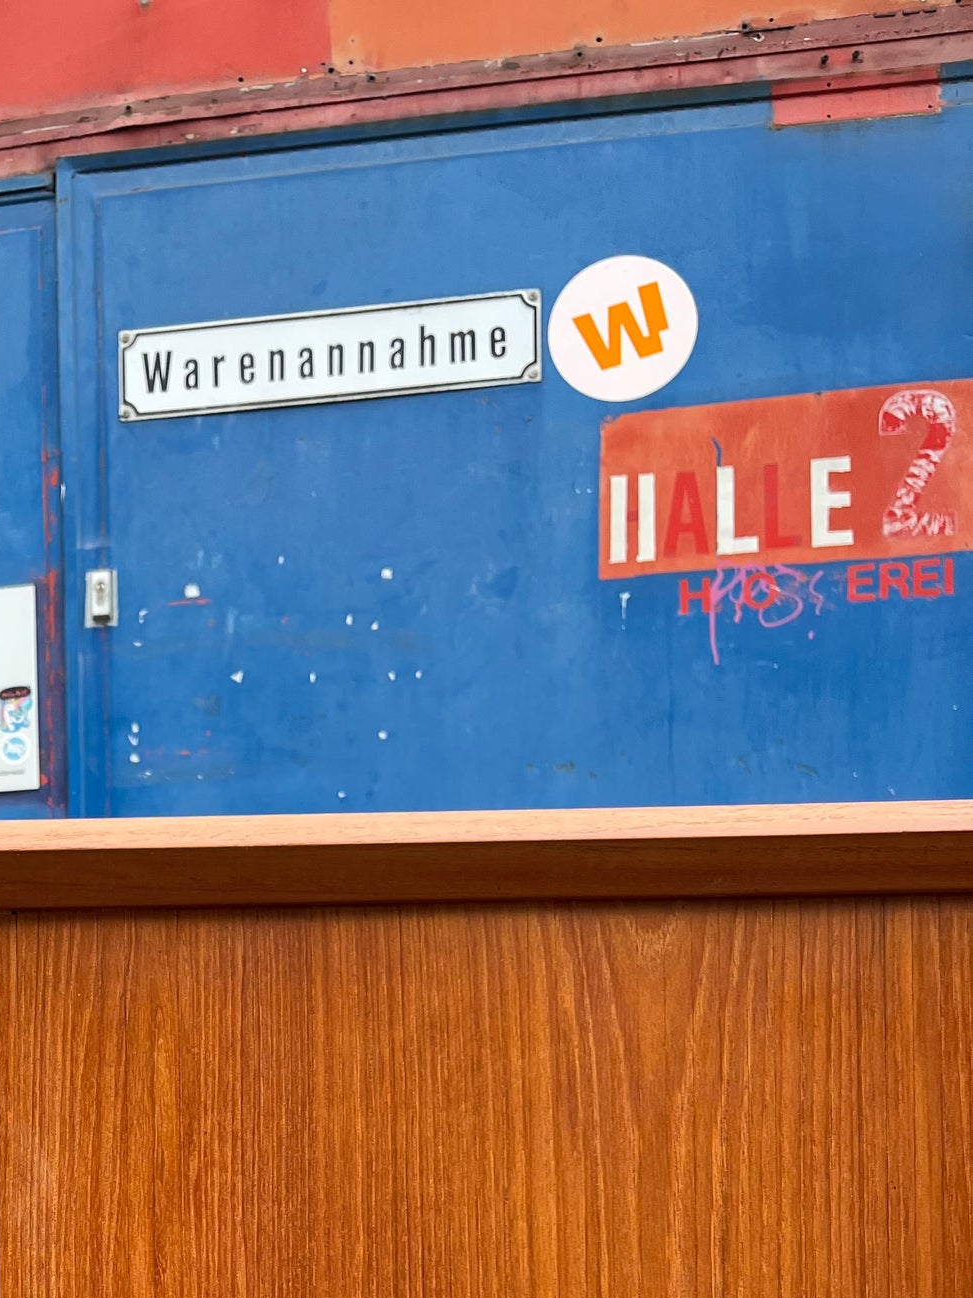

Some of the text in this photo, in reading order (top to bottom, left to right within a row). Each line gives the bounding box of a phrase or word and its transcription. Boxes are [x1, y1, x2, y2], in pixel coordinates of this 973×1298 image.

[143, 324, 507, 393] Warenannahme
[609, 389, 956, 565] HALLE 2
